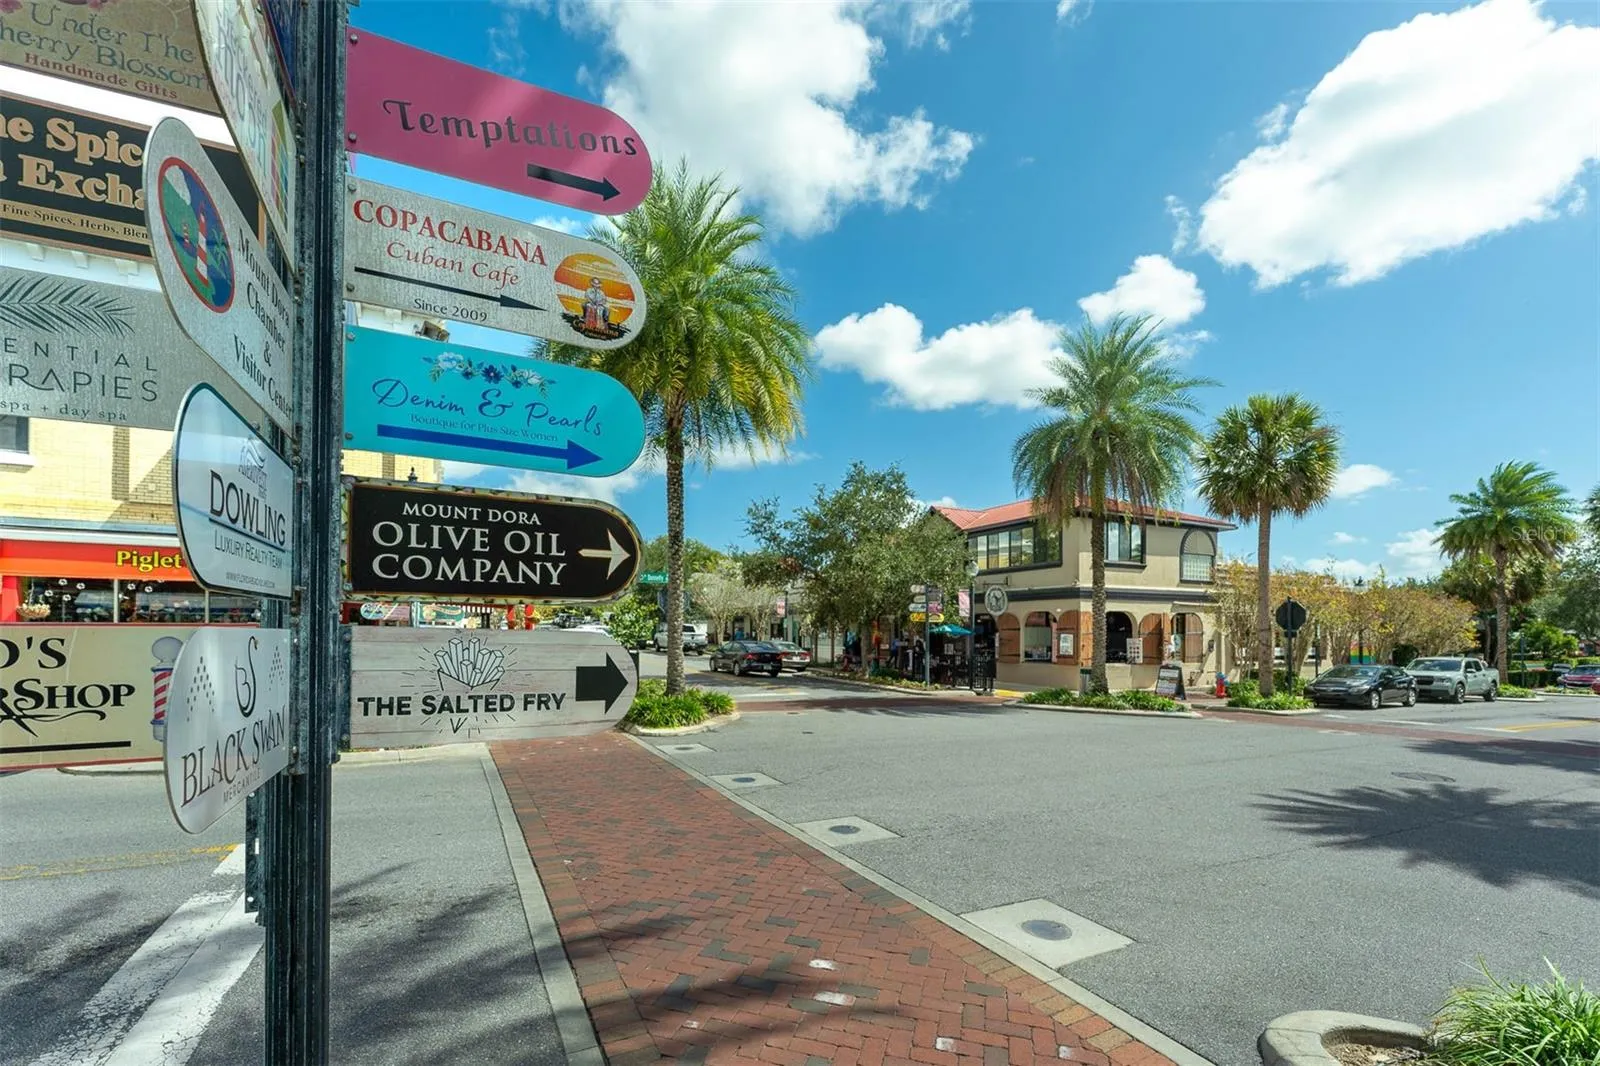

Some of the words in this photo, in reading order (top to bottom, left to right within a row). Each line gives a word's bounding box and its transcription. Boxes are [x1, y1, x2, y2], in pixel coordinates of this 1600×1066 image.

[31, 2, 127, 45] Under
[140, 31, 195, 62] The
[24, 52, 128, 87] Handmade
[135, 80, 178, 99] Gifts
[382, 99, 637, 156] Temptations
[2, 204, 31, 217] Fine
[33, 210, 76, 226] Spices,
[353, 199, 547, 266] COPACABANA
[386, 241, 464, 273] Cuban
[238, 228, 270, 296] Mount
[271, 283, 290, 329] Dora
[247, 282, 286, 352] Chamber
[413, 298, 447, 315] Since
[452, 304, 488, 323] 2009
[4, 337, 157, 372] ENTIAL
[263, 341, 272, 367] &
[9, 363, 157, 402] RAPIES
[234, 333, 267, 391] Visitor
[268, 376, 293, 421] Center
[59, 403, 91, 418] day
[99, 409, 127, 423] spa
[372, 378, 465, 416] Denim
[478, 388, 513, 418] &
[525, 402, 602, 436] Pearls
[411, 413, 458, 429] Boutique
[461, 421, 475, 431] for
[477, 423, 497, 434] Plus
[500, 426, 518, 437] Size
[521, 430, 558, 442] Women
[209, 469, 286, 546] DOWLING
[402, 502, 481, 521] MOUNT
[487, 509, 542, 526] DORA
[372, 521, 490, 552] OLIVE
[503, 530, 567, 557] OIL
[117, 550, 182, 572] Piglet
[372, 553, 567, 586] COMPANY
[357, 696, 411, 716] THE
[421, 693, 516, 716] SALTED
[522, 693, 567, 712] FRY
[181, 727, 250, 808] BLACK
[253, 704, 286, 765] SWAN
